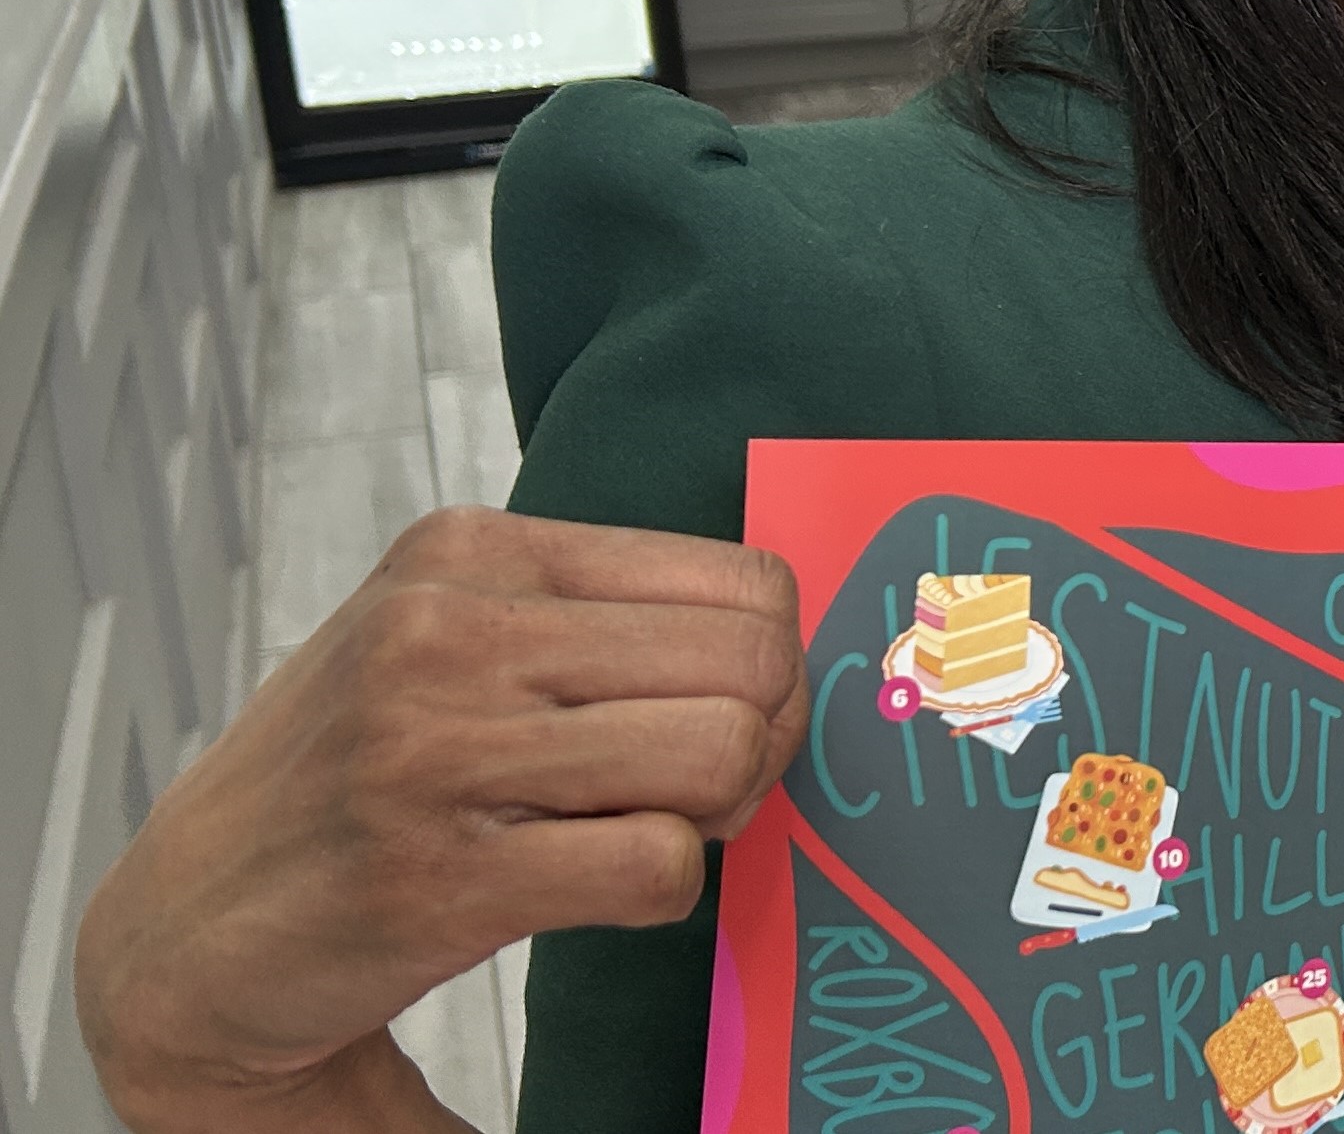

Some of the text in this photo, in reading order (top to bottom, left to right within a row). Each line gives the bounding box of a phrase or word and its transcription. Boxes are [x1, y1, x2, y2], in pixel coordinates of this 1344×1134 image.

[891, 688, 909, 709] 6
[1158, 848, 1184, 869] 10
[1301, 968, 1328, 989] 25
